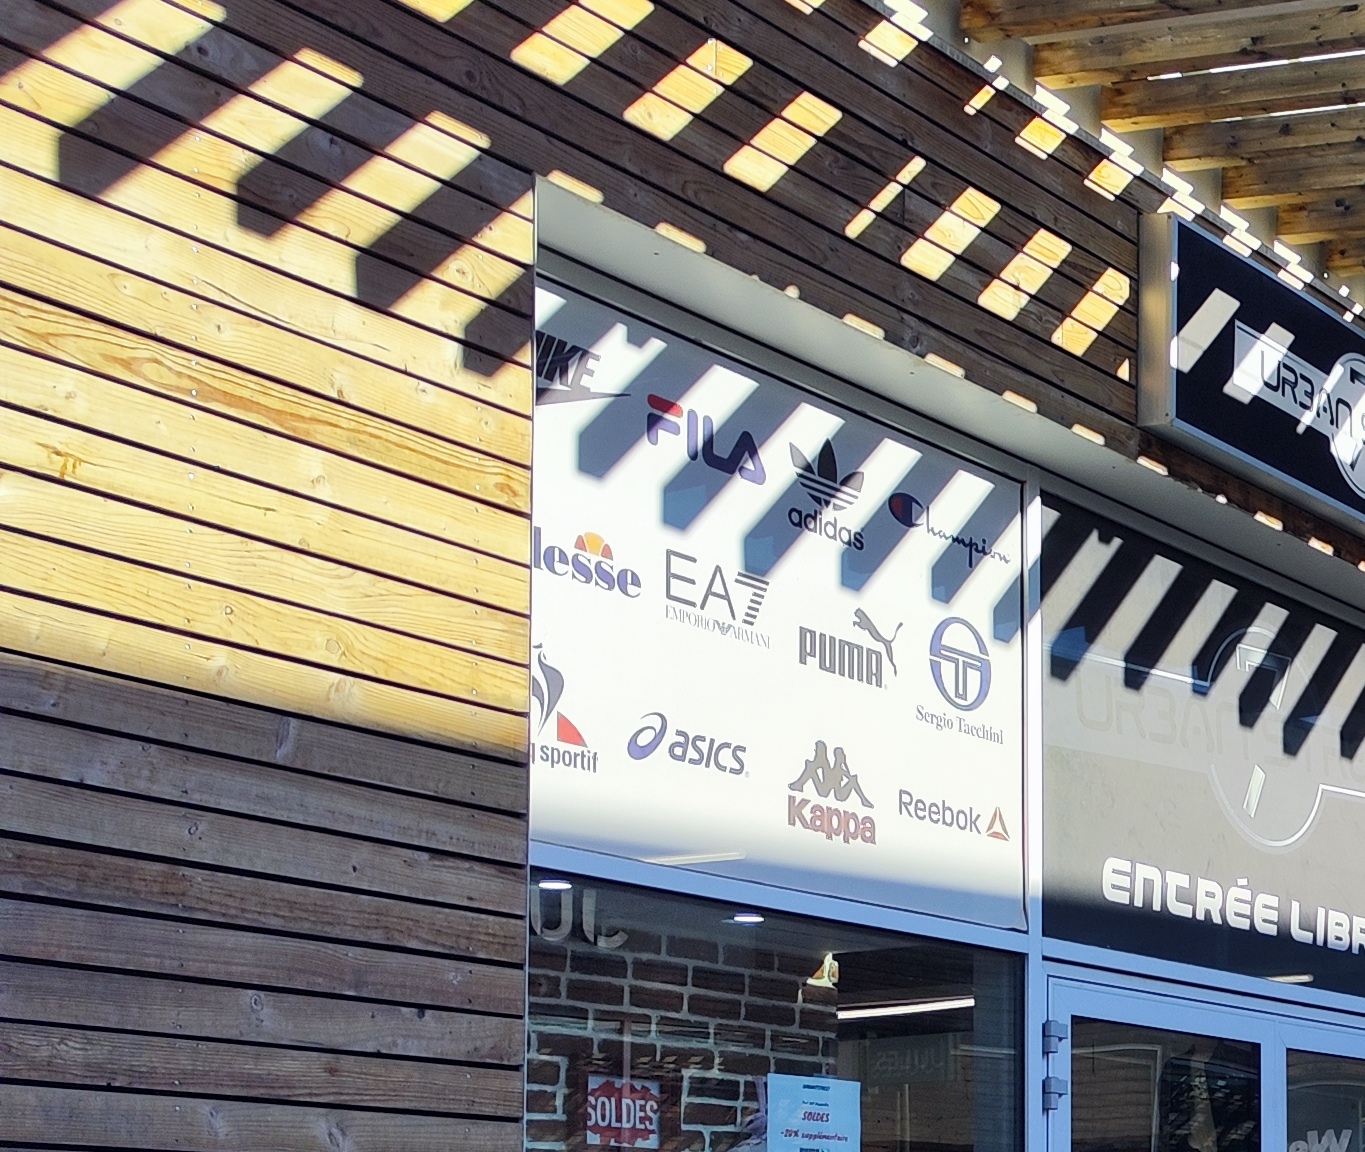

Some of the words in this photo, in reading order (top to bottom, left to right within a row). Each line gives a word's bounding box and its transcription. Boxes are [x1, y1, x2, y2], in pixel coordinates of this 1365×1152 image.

[647, 394, 766, 485] FILA
[788, 507, 865, 551] adidas
[888, 493, 1011, 569] Champion
[666, 549, 770, 626] EA7
[665, 604, 716, 633] EMPORIO
[730, 626, 771, 649] ARMANI
[799, 626, 882, 689] PUMA
[916, 705, 953, 732] Sergio
[956, 716, 1004, 744] Tacchini
[540, 744, 599, 773] sportif
[668, 729, 747, 776] asics
[788, 794, 876, 845] Kappa
[899, 789, 982, 836] Reebok
[1102, 856, 1280, 937] ENTRÉE
[587, 1095, 659, 1131] SOLDES
[801, 1111, 830, 1122] SOLDES
